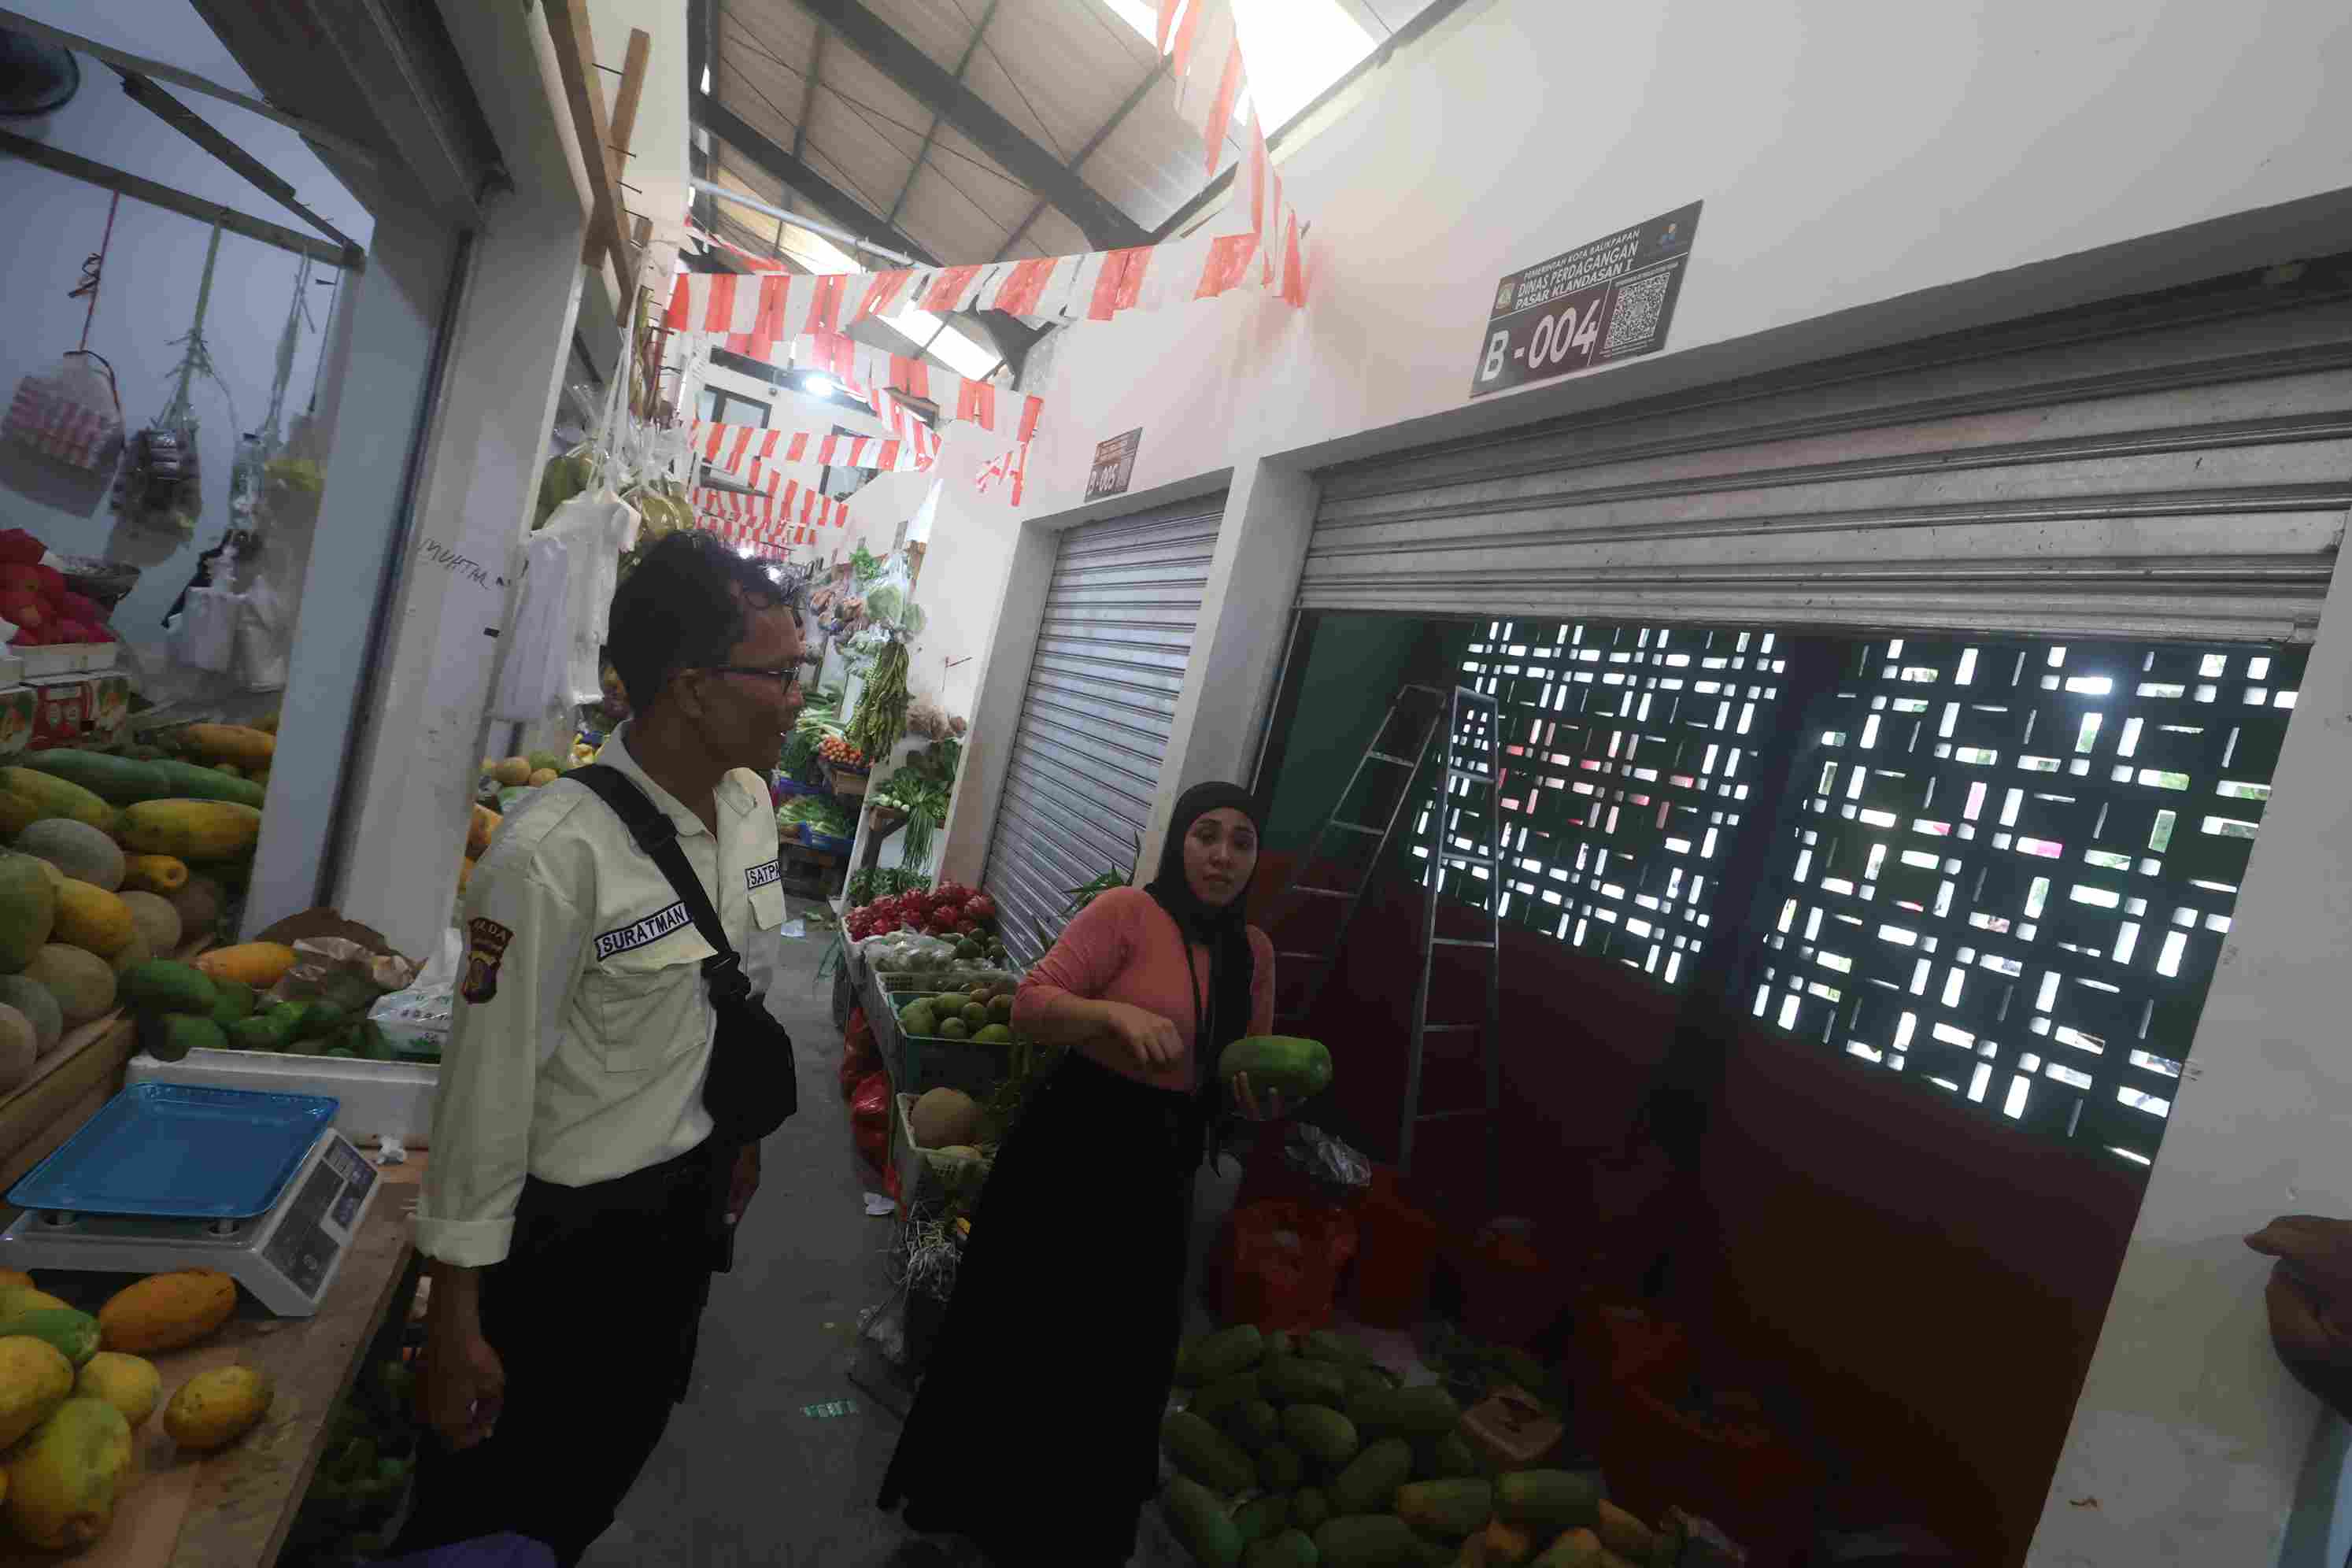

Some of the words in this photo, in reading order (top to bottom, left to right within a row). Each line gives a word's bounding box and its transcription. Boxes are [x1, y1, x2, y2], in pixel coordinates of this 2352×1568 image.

[1515, 289, 1550, 309] PASAR
[1551, 264, 1624, 298] KLANDASAN
[1518, 274, 1550, 298] DINAS
[1550, 241, 1639, 286] PERDAGANGAN
[749, 862, 782, 885] SATPA
[602, 905, 686, 952] SURATMAN
